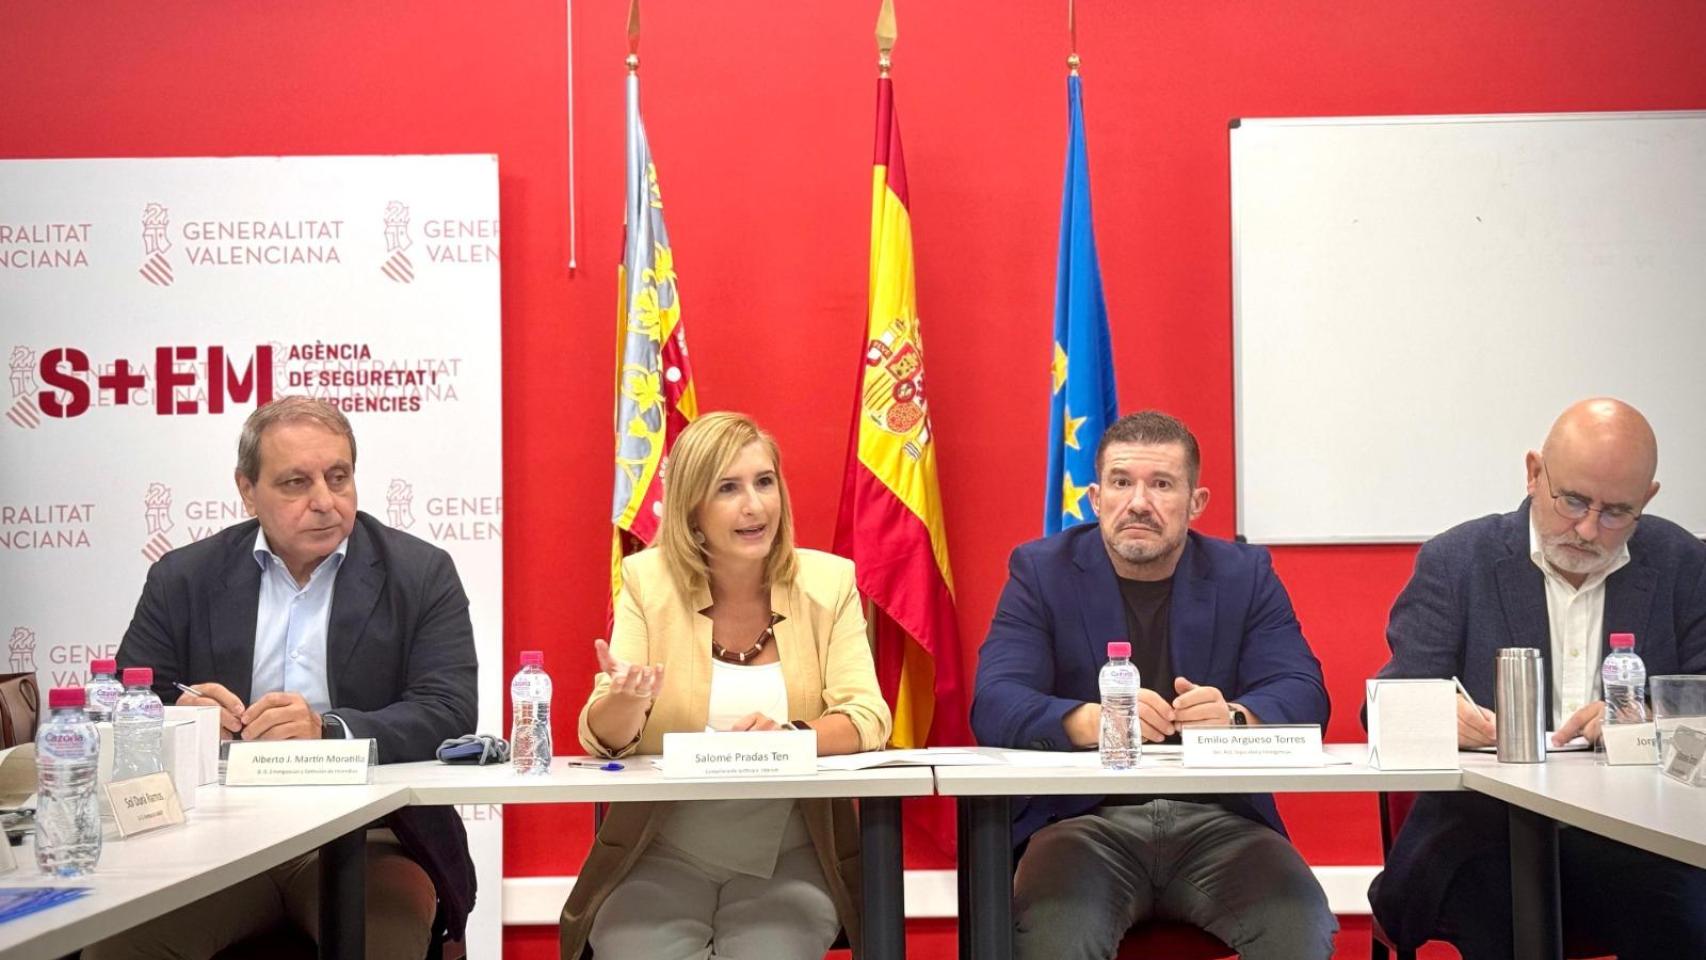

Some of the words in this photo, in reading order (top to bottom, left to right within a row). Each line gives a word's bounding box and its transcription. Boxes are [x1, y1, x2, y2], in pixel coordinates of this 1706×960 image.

[183, 220, 344, 241] GENERALITAT
[185, 245, 341, 265] VALENCIANA
[288, 340, 371, 361] AGÈNCIA
[38, 345, 273, 418] S+EM
[289, 371, 314, 387] DE
[318, 370, 426, 387] SEGURETAT
[431, 370, 436, 385] I
[1197, 735, 1229, 745] Emilio
[1274, 734, 1306, 744] Torres
[252, 754, 285, 764] Alberto
[695, 753, 733, 764] Salomé
[735, 752, 769, 763] Pradas
[770, 751, 789, 761] Ten
